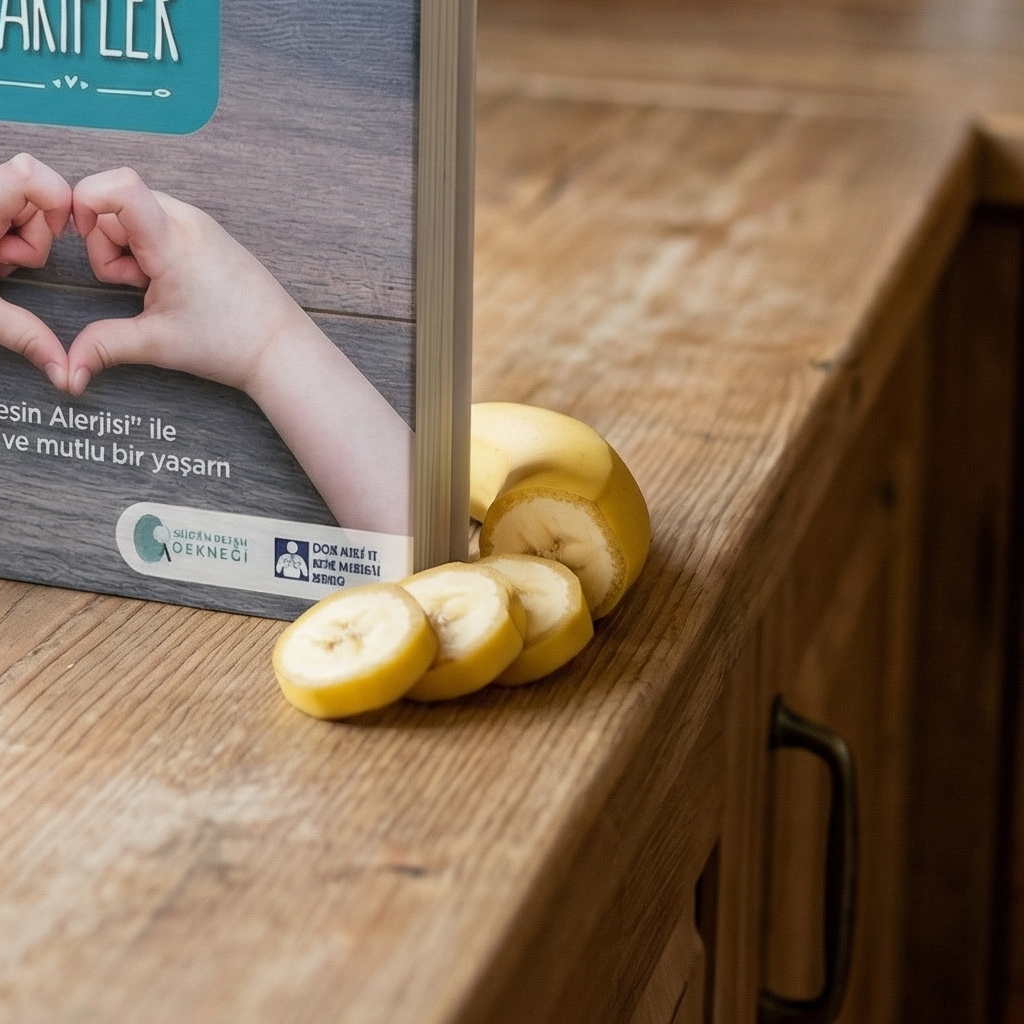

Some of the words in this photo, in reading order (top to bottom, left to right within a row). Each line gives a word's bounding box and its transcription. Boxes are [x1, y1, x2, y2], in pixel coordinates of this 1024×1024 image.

[149, 417, 177, 442] ile
[2, 432, 29, 452] ve
[36, 437, 105, 463] mutlu
[112, 442, 145, 467] bir
